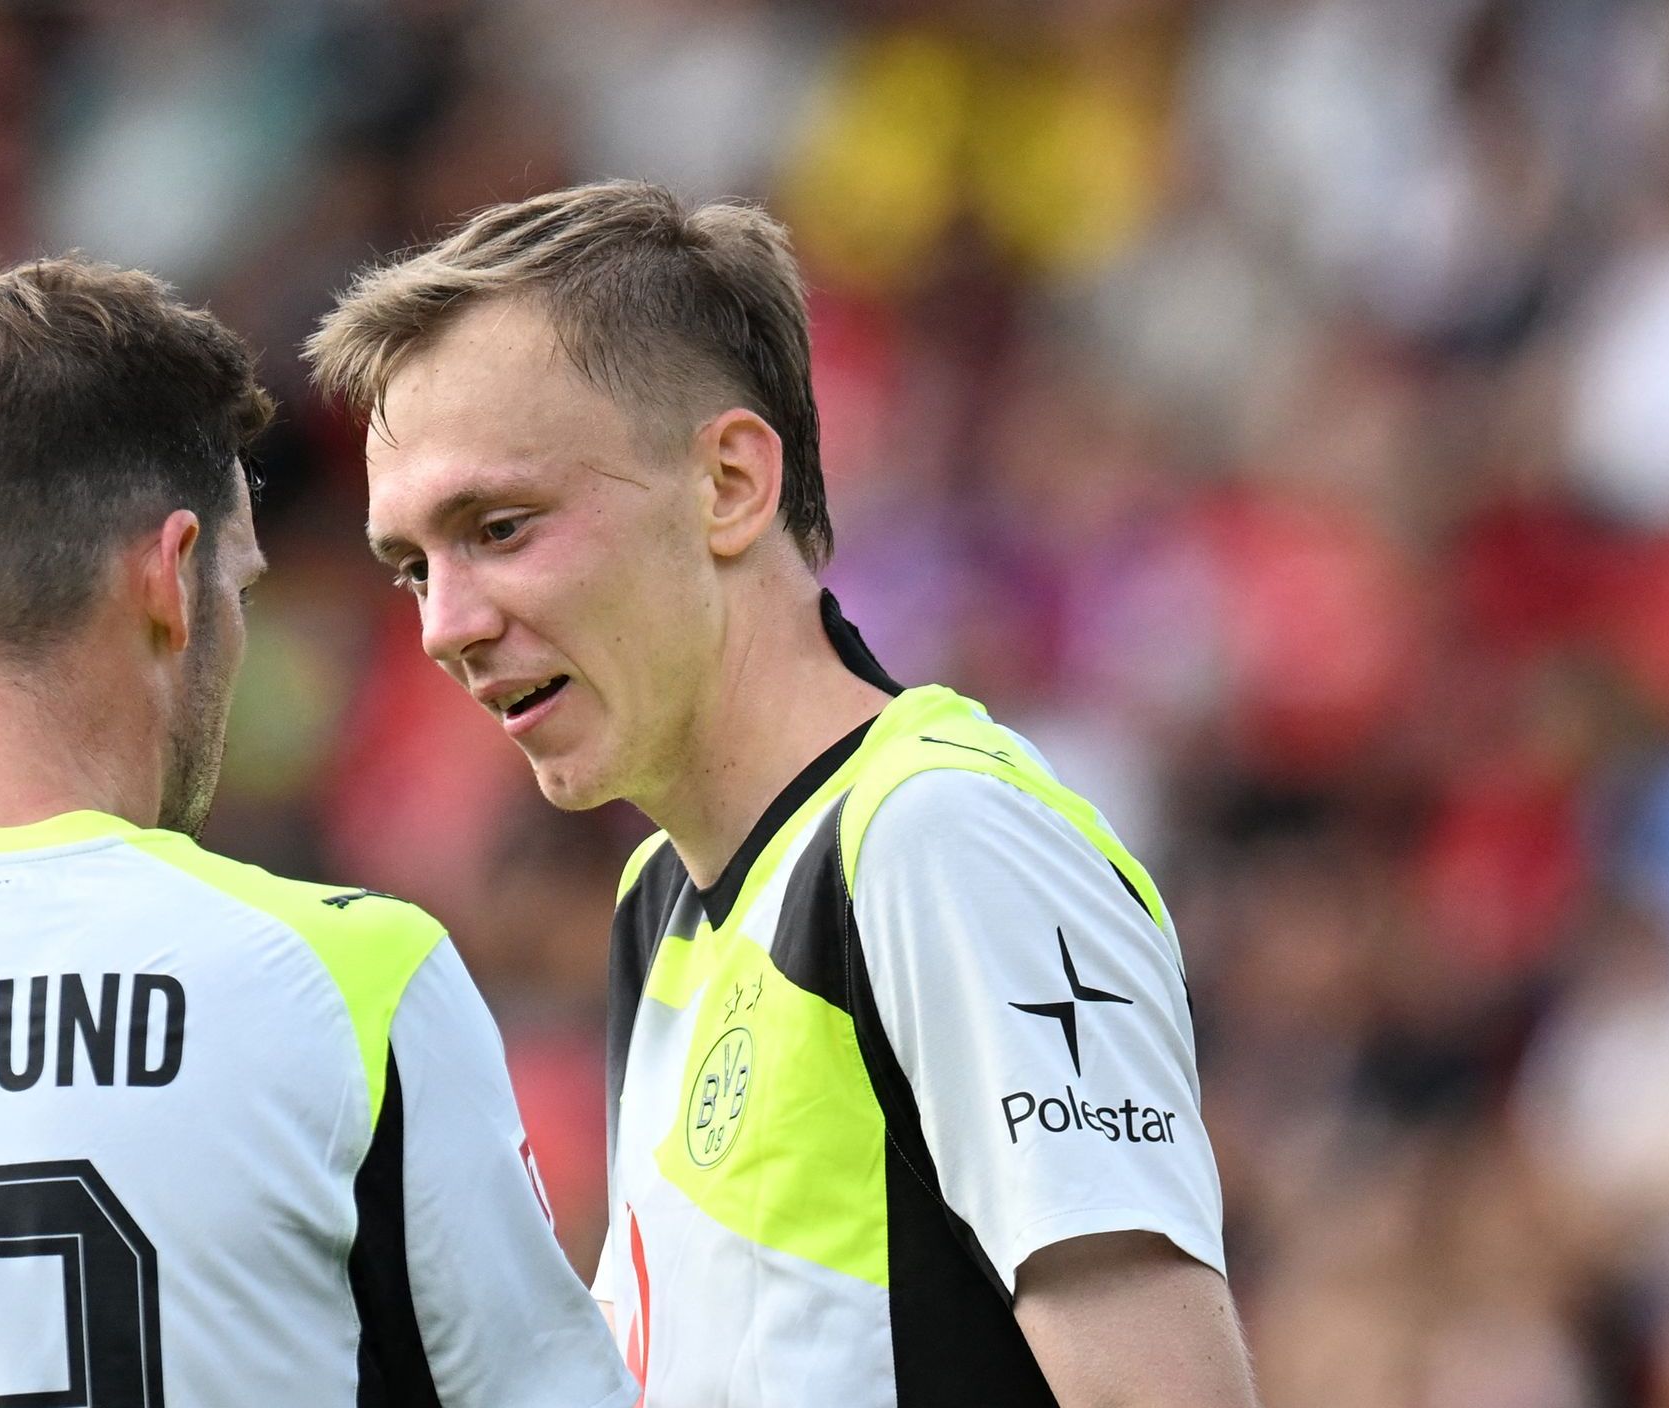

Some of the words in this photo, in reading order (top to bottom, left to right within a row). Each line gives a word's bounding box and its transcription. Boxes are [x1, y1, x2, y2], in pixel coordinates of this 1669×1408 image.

[696, 1038, 749, 1130] BVB
[704, 1124, 725, 1155] 09
[1001, 1085, 1176, 1145] Polestar
